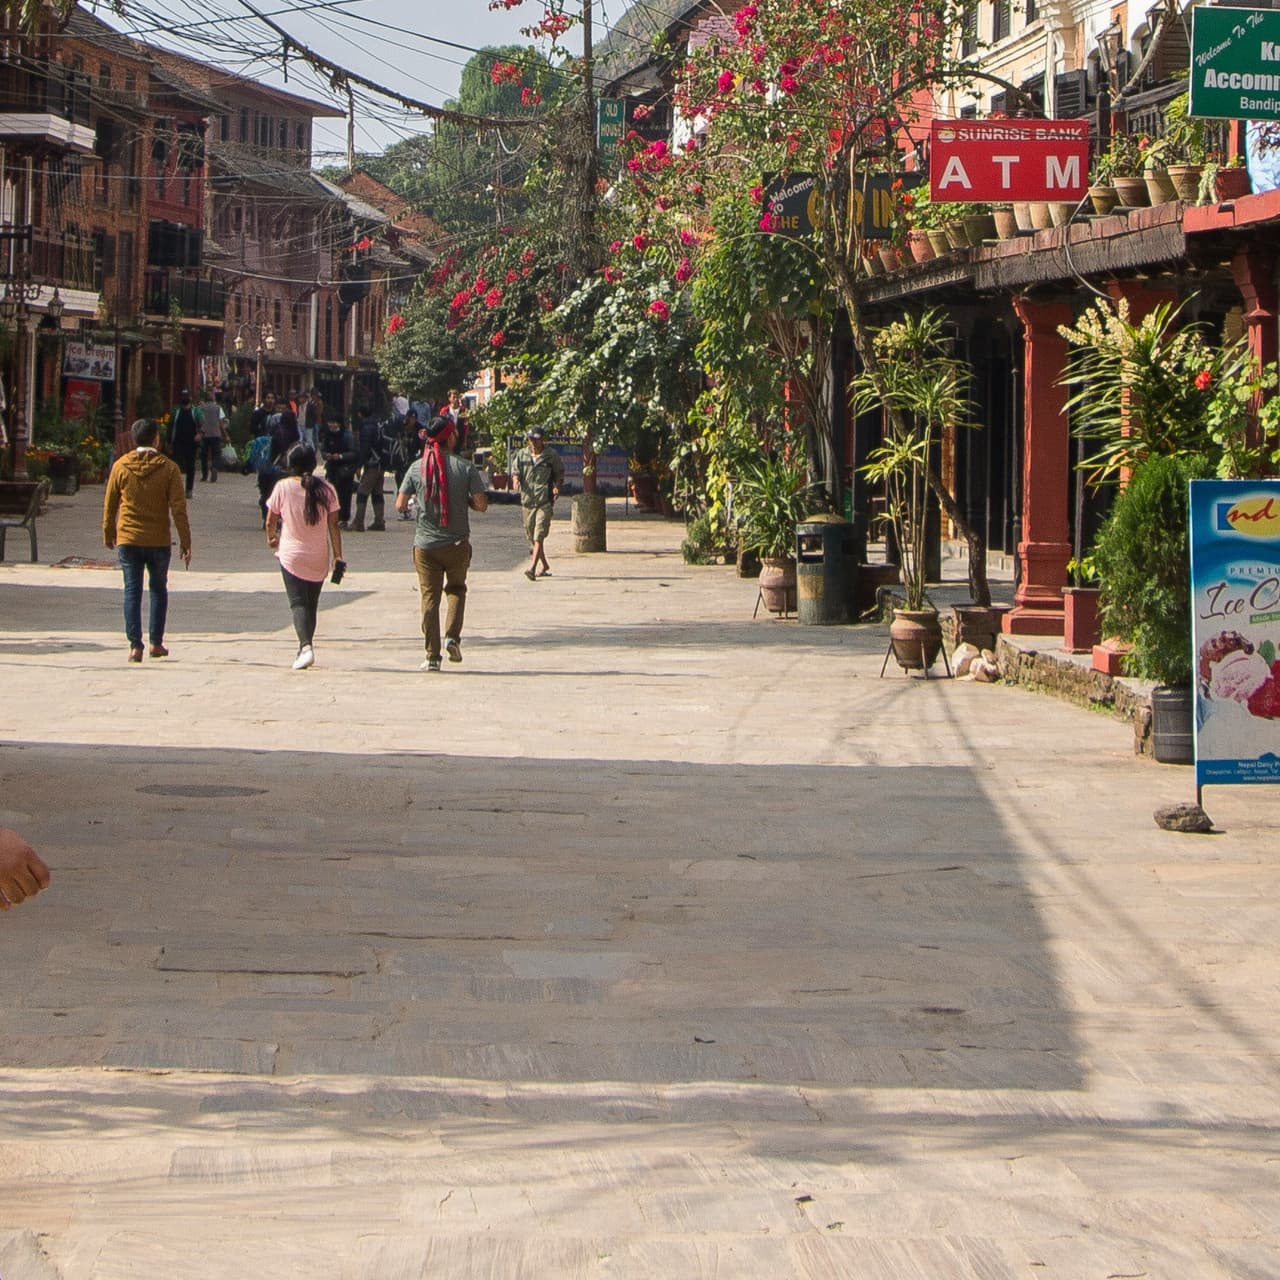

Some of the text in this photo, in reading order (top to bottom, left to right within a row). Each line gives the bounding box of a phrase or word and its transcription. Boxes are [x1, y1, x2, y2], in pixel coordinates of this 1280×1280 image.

[1195, 11, 1264, 67] Welcome To The
[959, 127, 1083, 141] SUNRISE BANK
[770, 176, 813, 204] Welcome
[807, 188, 865, 228] OD
[1200, 582, 1245, 620] Ice
